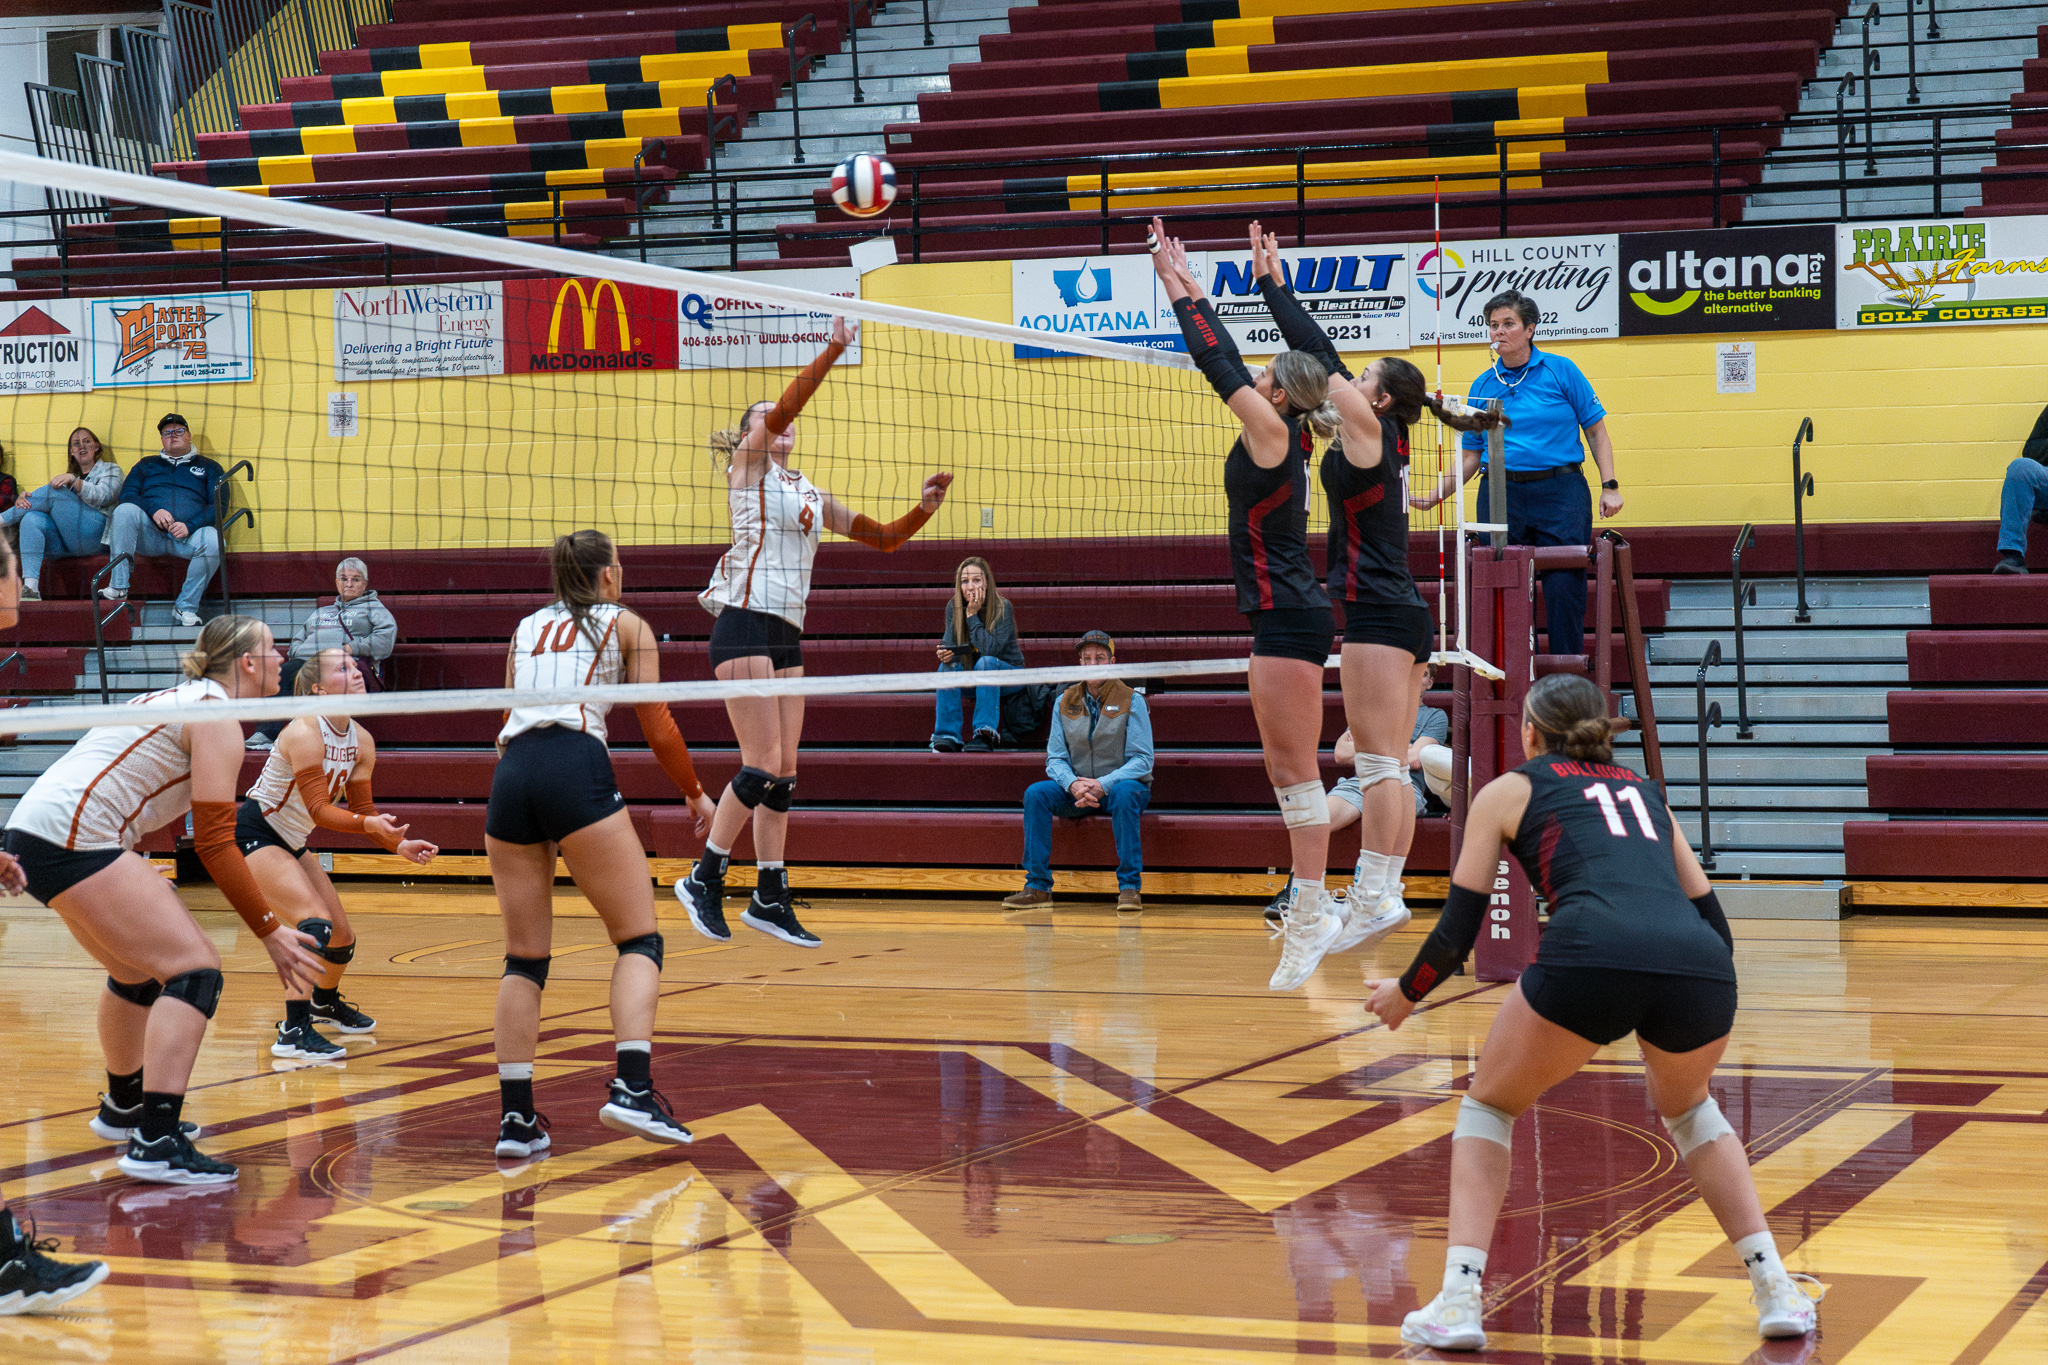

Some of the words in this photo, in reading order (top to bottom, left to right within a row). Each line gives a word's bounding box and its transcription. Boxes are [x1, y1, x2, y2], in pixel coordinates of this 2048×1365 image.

[1852, 223, 1986, 264] PRAIRIE
[1472, 248, 1514, 263] HILL
[1522, 243, 1606, 261] COUNTY
[1628, 250, 1808, 291] altana
[1809, 253, 1826, 284] fcu
[1945, 247, 2048, 283] Farms
[1455, 260, 1612, 319] printing
[1704, 289, 1724, 301] the
[1727, 288, 1766, 300] better
[1769, 287, 1822, 299] banking
[342, 288, 494, 317] NorthWestern
[1217, 303, 1271, 315] Plumb
[1301, 301, 1313, 311] &
[1317, 298, 1386, 310] Heating
[1391, 299, 1404, 307] inc
[1703, 301, 1773, 314] alternative
[1861, 310, 1929, 323] GOLF
[1938, 305, 2046, 320] COURSE
[438, 314, 494, 336] Energy
[1534, 326, 1609, 337] untyprinting.com
[682, 334, 751, 347] 406-265-9611
[1420, 332, 1434, 341] 524
[1457, 331, 1483, 339] Street
[0, 340, 78, 364] RUCTION
[183, 341, 206, 360] 72
[344, 341, 402, 356] Delivering
[405, 344, 412, 352] a
[415, 340, 451, 354] Bright
[454, 338, 494, 350] Future
[342, 358, 373, 367] Providing
[402, 355, 442, 364] competitively
[443, 354, 463, 363] priced
[464, 353, 494, 362] electricity
[529, 350, 653, 370] McDonald's
[5, 370, 55, 380] CONTRACTOR
[356, 367, 369, 375] and
[369, 366, 394, 375] natural
[406, 365, 417, 376] for
[437, 364, 450, 372] than
[451, 363, 461, 371] 80
[462, 364, 480, 372] years
[35, 379, 85, 388] COMMERCIAL
[531, 617, 578, 657] 10
[1583, 782, 1660, 842] 11
